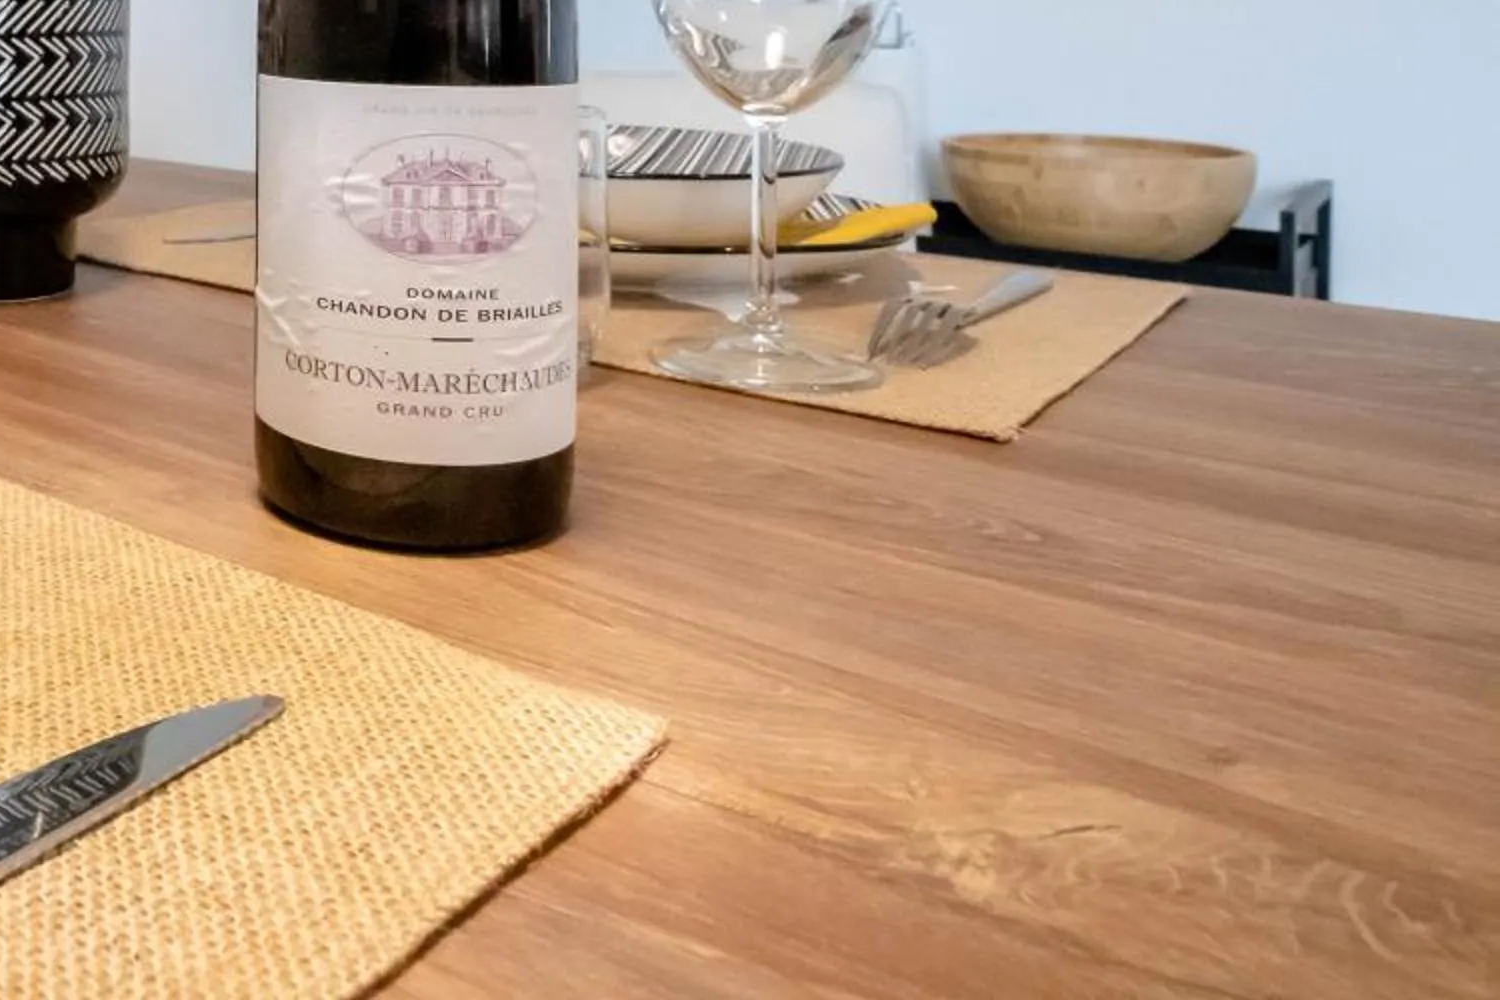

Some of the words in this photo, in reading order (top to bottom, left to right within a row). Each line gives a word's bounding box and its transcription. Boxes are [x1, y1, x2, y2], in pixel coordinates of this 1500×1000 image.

[405, 286, 500, 301] DOMAINE
[316, 296, 428, 322] CHANDON
[437, 308, 468, 323] DE
[477, 299, 563, 323] BRIAILLES
[284, 348, 572, 395] CORTON-MARÉCHAUDES
[376, 401, 453, 418] GRAND
[462, 404, 505, 418] CRU
